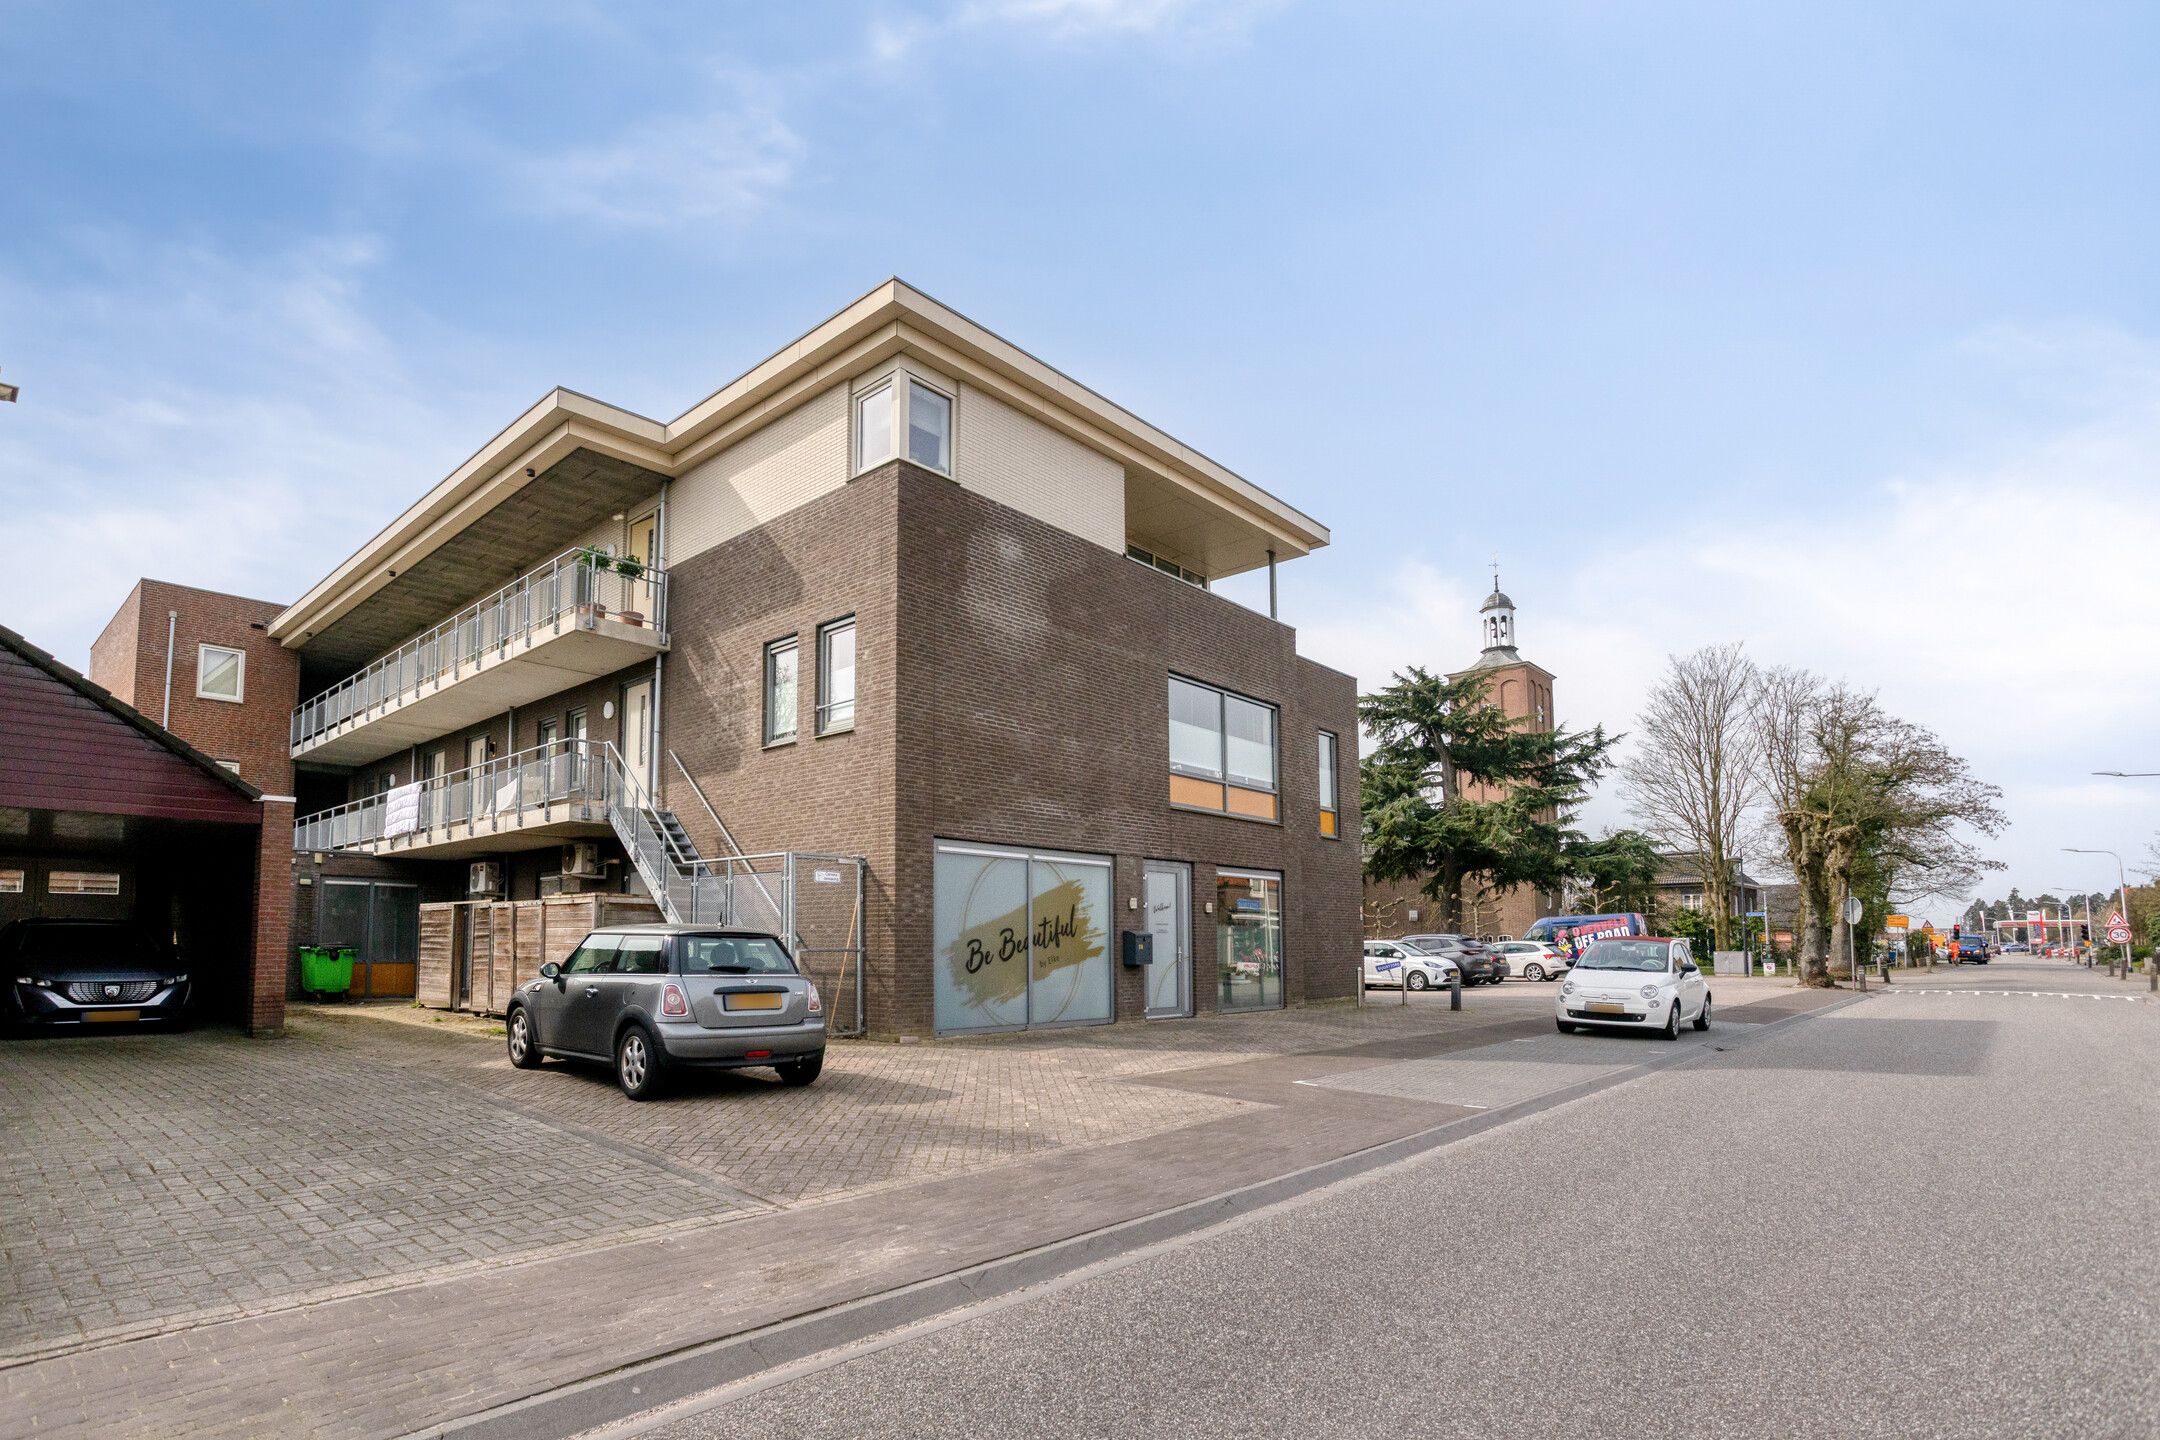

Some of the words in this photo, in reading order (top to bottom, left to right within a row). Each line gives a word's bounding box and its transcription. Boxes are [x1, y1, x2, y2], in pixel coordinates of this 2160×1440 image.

[1572, 916, 1628, 937] OVERVELD
[2112, 931, 2127, 939] 30
[966, 938, 994, 974] Be
[999, 904, 1077, 962] Beautiful
[1574, 934, 1595, 950] OFF
